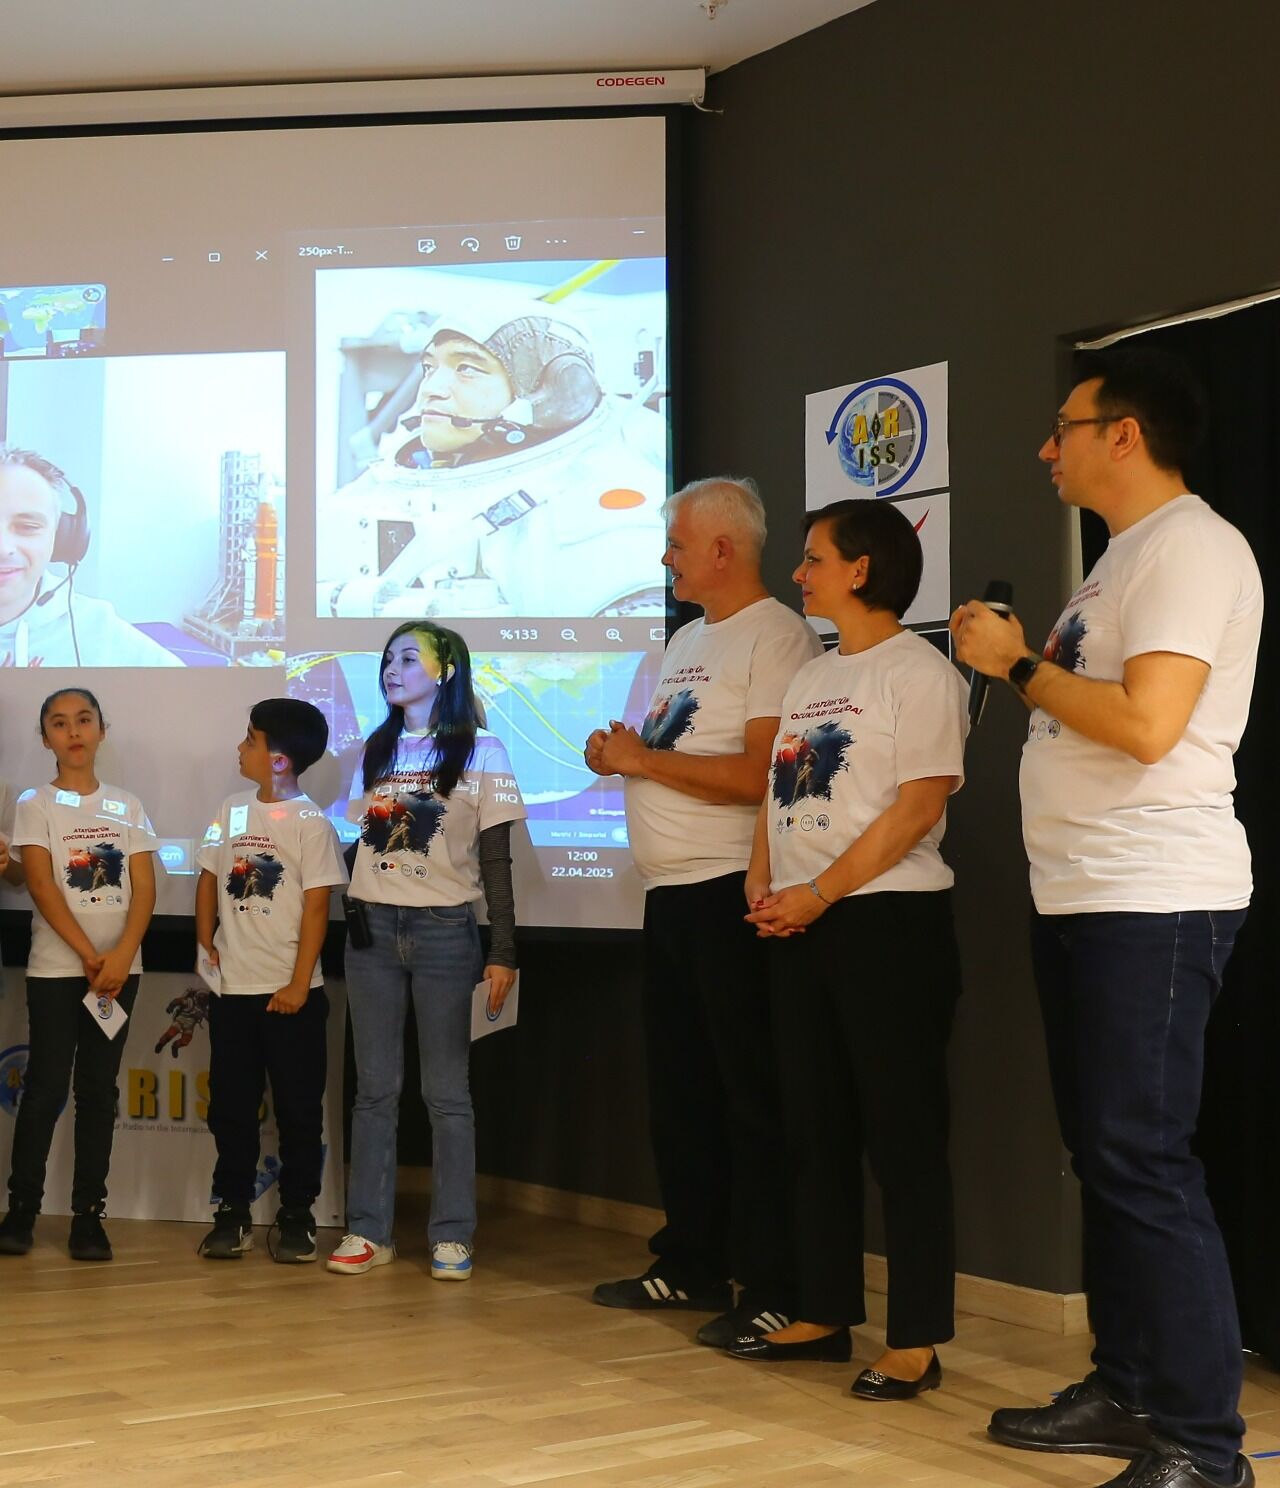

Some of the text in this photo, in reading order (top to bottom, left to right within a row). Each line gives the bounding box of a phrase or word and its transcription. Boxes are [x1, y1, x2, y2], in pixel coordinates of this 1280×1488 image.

[596, 77, 665, 87] CODEGEN
[859, 442, 896, 469] ISS
[500, 628, 538, 640] %133
[492, 778, 517, 790] TUR
[567, 851, 598, 862] 12:00
[551, 866, 614, 878] 22.04.2025
